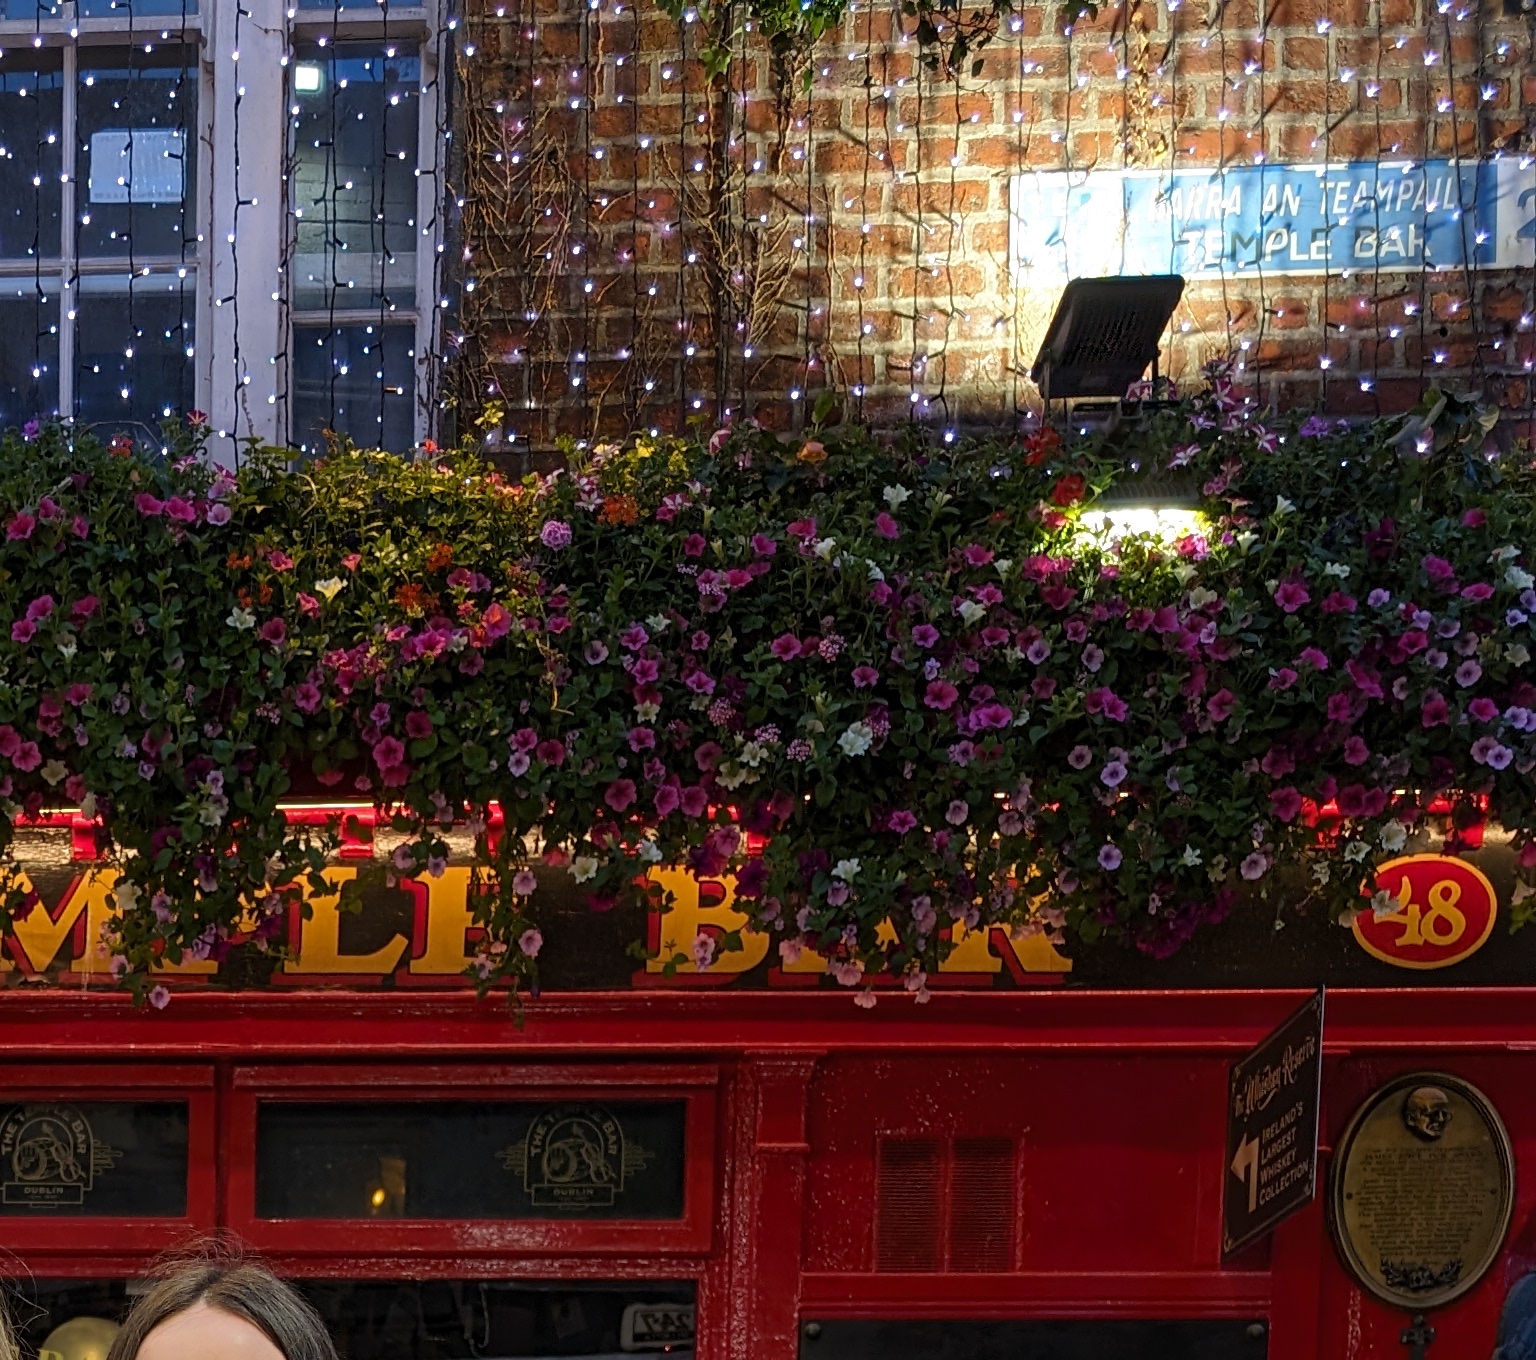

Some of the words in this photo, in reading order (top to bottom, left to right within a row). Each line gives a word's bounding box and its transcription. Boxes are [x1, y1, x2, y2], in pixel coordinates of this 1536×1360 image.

[1262, 182, 1301, 217] AN
[1180, 226, 1333, 265] TEMPLE
[1353, 223, 1432, 260] BAR
[1373, 875, 1467, 947] 48
[1, 1123, 18, 1156] THE
[71, 1119, 88, 1154] BAR
[1262, 1101, 1304, 1144] IRELAND'S
[1261, 1126, 1297, 1165] LARGEST
[1259, 1158, 1309, 1206] COLLECTION
[1260, 1149, 1297, 1185] WHISKEY
[23, 1186, 64, 1195] DUBLIN
